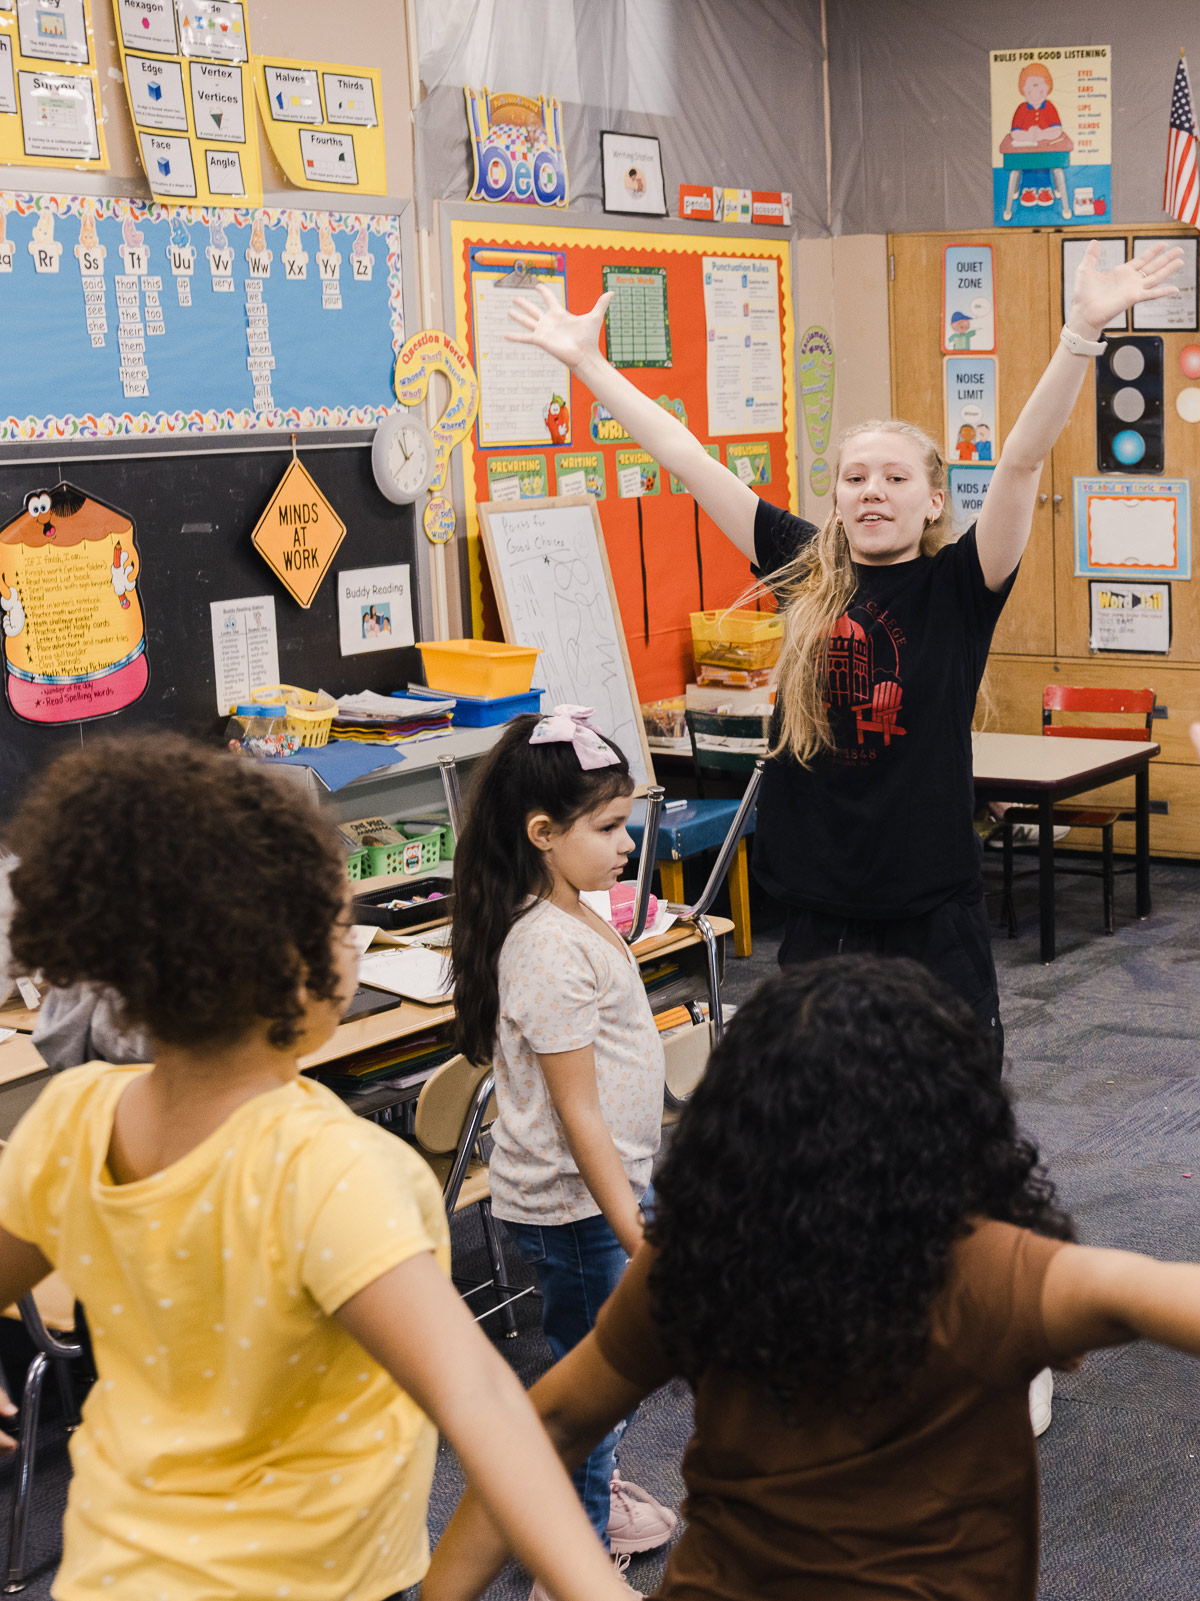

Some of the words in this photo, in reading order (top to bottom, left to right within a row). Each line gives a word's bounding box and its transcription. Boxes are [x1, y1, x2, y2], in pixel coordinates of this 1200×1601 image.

[994, 52, 1017, 62] RULES
[1019, 52, 1034, 61] FOR
[1038, 51, 1062, 60] GOOD
[1064, 49, 1107, 59] LISTENING
[141, 62, 163, 75] Edge
[200, 66, 232, 79] Vertex
[275, 71, 306, 84] Halves
[337, 80, 365, 91] Thirds
[197, 91, 239, 104] Vertices
[151, 138, 172, 150] Face
[311, 135, 344, 147] Fourths
[210, 156, 236, 168] Angle
[685, 195, 711, 214] pencils
[726, 199, 738, 217] glue
[754, 203, 782, 215] scissors
[38, 252, 54, 268] Rr
[84, 252, 99, 270] Ss
[129, 252, 141, 269] Tt
[173, 253, 191, 269] Uu
[212, 254, 229, 271] Vv
[250, 257, 269, 274] Ww
[287, 260, 304, 275] Xx
[321, 258, 337, 277] Yy
[356, 260, 369, 275] Zz
[712, 261, 751, 272] Punctuation
[752, 263, 769, 273] Rules
[956, 262, 984, 273] QUIET
[83, 279, 104, 290] said
[116, 280, 138, 290] than
[142, 279, 161, 289] this
[214, 279, 232, 289] very
[323, 282, 338, 291] you
[957, 278, 983, 289] ZONE
[86, 293, 103, 302] saw
[147, 294, 157, 303] to
[323, 296, 341, 305] your
[121, 310, 139, 320] the
[88, 321, 106, 331] she
[147, 323, 164, 333] two
[248, 329, 267, 339] what
[401, 333, 441, 366] Question
[443, 336, 467, 370] Words
[248, 358, 274, 368] where
[121, 368, 147, 379] there
[253, 372, 270, 382] who
[400, 366, 426, 386] Whose?
[955, 373, 985, 384] NOISE
[125, 382, 146, 394] they
[957, 389, 984, 400] LIMIT
[440, 419, 467, 430] Where?
[728, 444, 768, 456] PUBLISHING
[491, 460, 541, 473] PREWRITING
[560, 456, 597, 468] WRITING
[278, 503, 319, 526] MINDS
[293, 526, 308, 548] AT
[507, 537, 531, 555] Good
[282, 548, 320, 572] WORK
[345, 585, 371, 600] Buddy
[372, 583, 404, 599] Reading
[1097, 591, 1132, 609] Word
[45, 696, 63, 706] Read
[65, 690, 92, 703] Spelling
[845, 748, 877, 760] 1848
